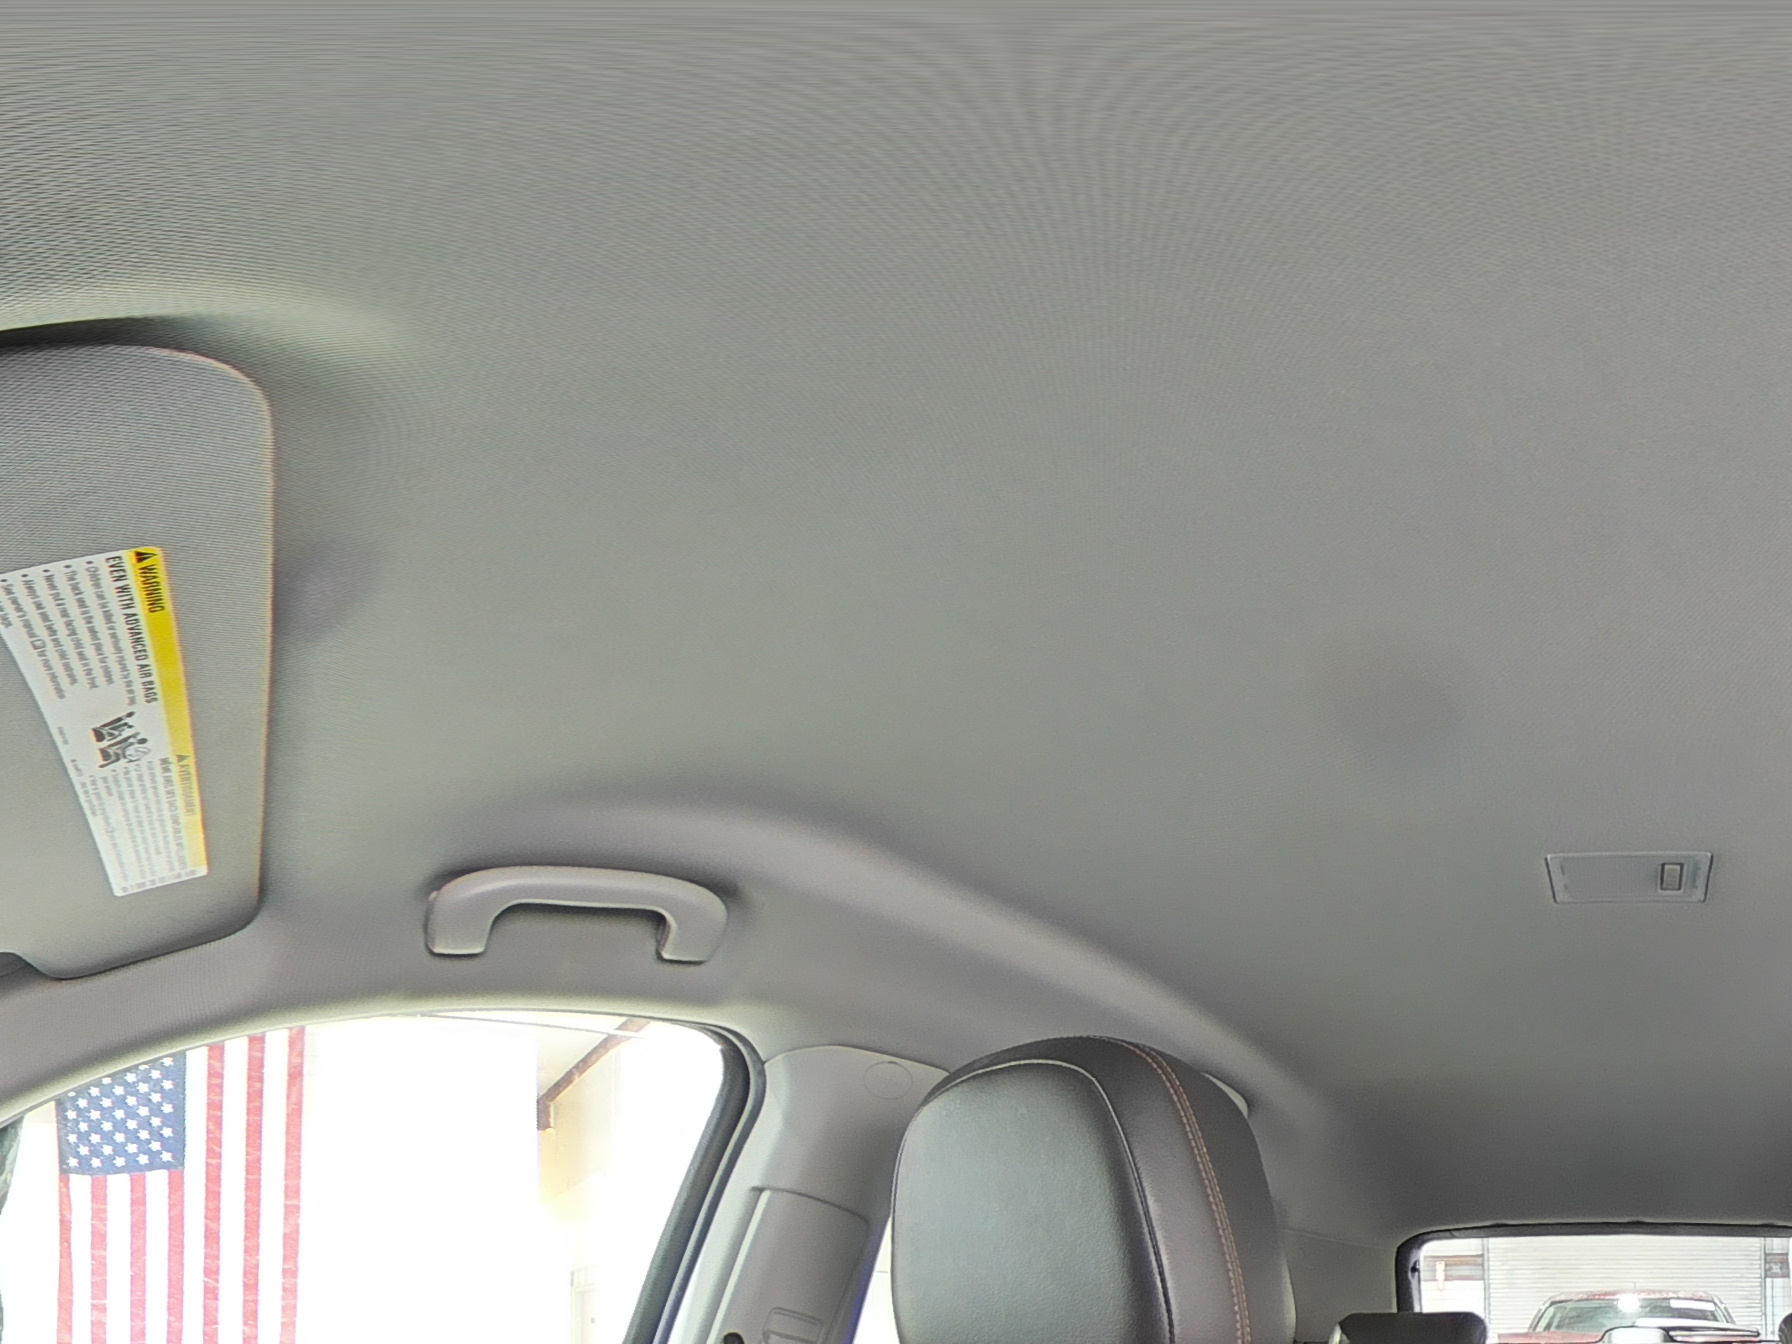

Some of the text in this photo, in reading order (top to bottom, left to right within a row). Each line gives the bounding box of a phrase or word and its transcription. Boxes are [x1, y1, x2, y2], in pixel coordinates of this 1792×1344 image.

[104, 554, 158, 704] EVEN WITH ADVANCED AIR BAGS
[138, 563, 165, 614] WARNING
